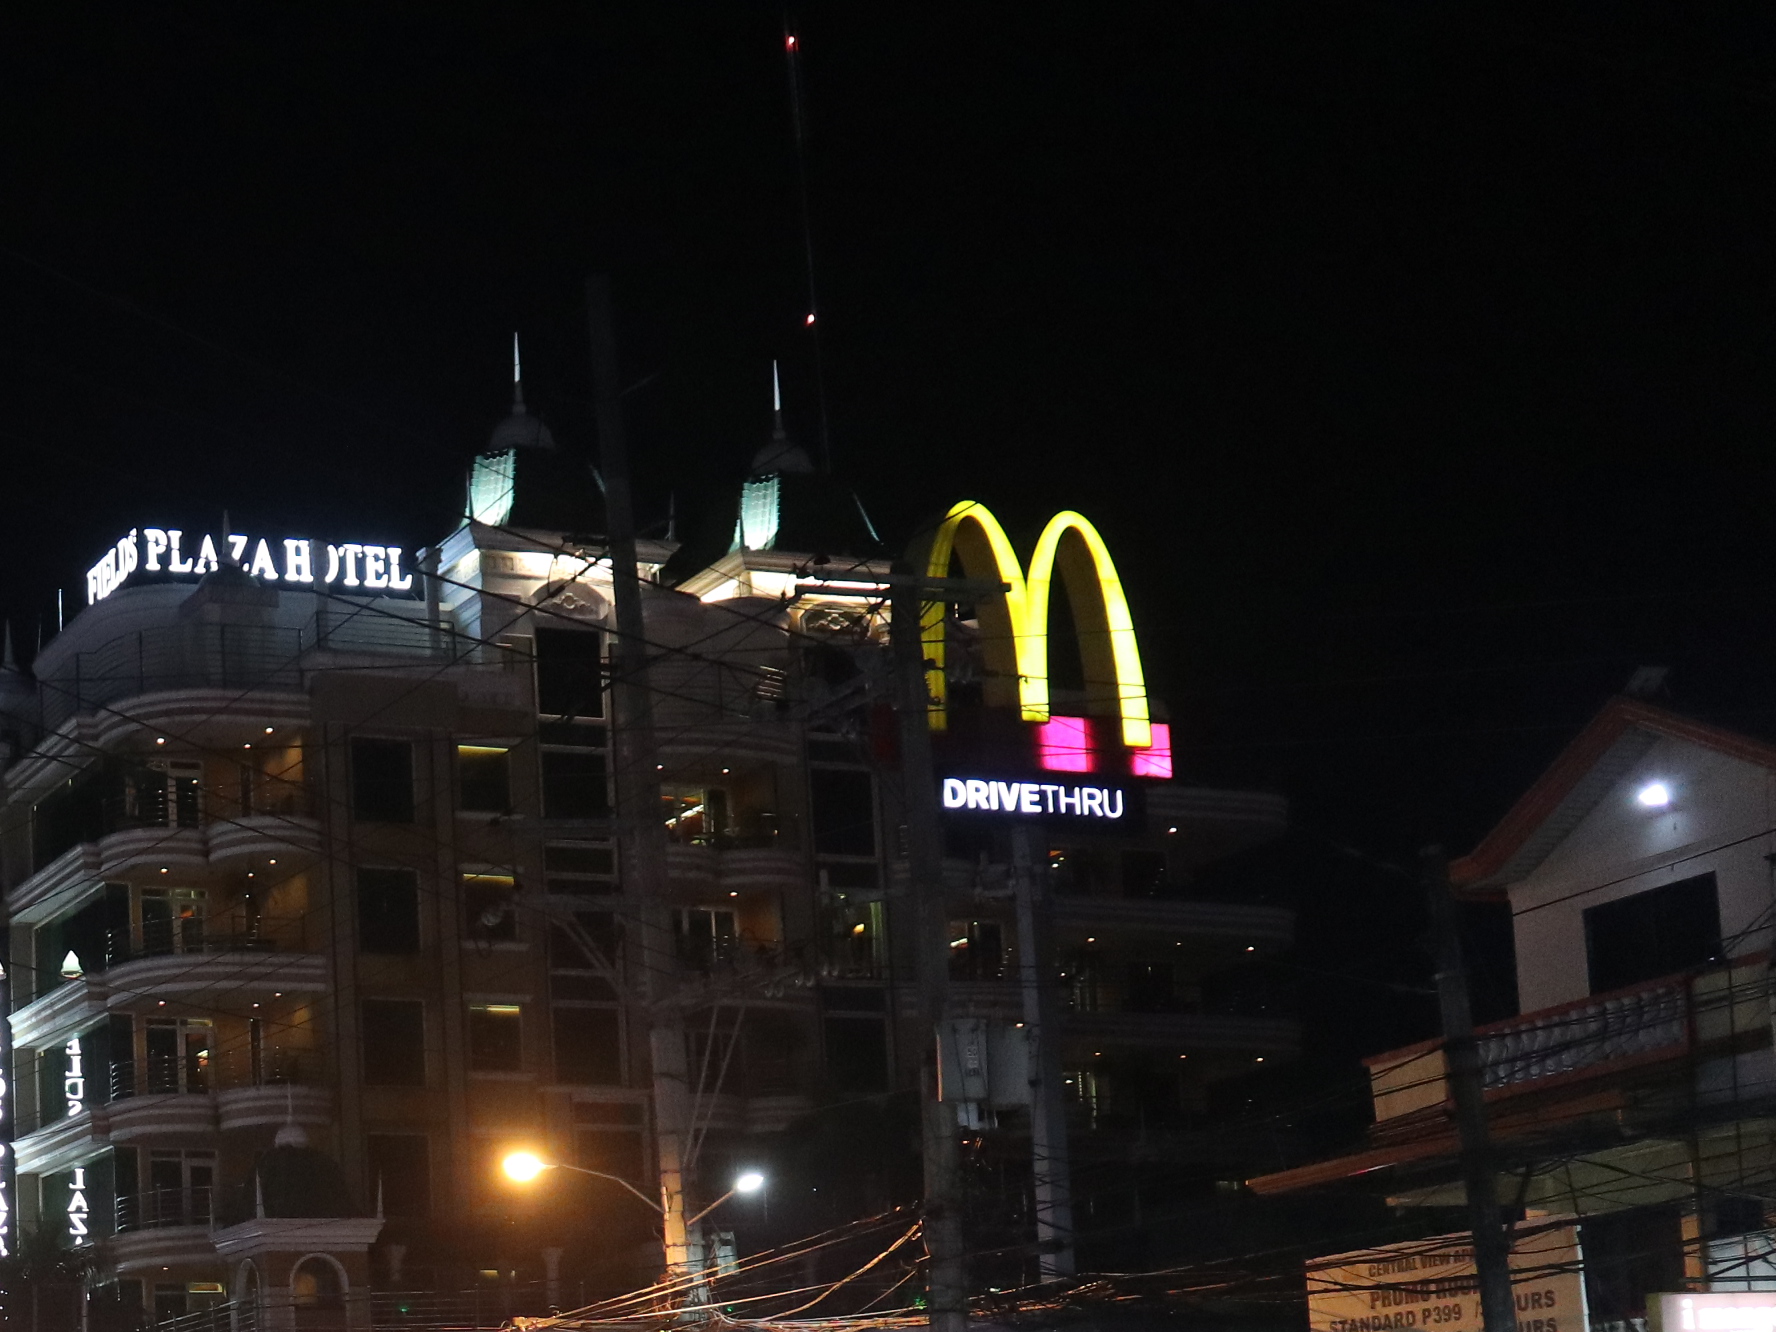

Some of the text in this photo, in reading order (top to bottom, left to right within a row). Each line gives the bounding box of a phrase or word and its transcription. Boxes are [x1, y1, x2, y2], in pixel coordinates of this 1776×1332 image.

[86, 528, 138, 605] FIELDS
[144, 528, 279, 581] PLAZA
[1367, 1256, 1418, 1277] CENTRAL
[1420, 1251, 1453, 1269] VIEW
[1422, 1303, 1462, 1325] P399
[1515, 1289, 1556, 1312] URS
